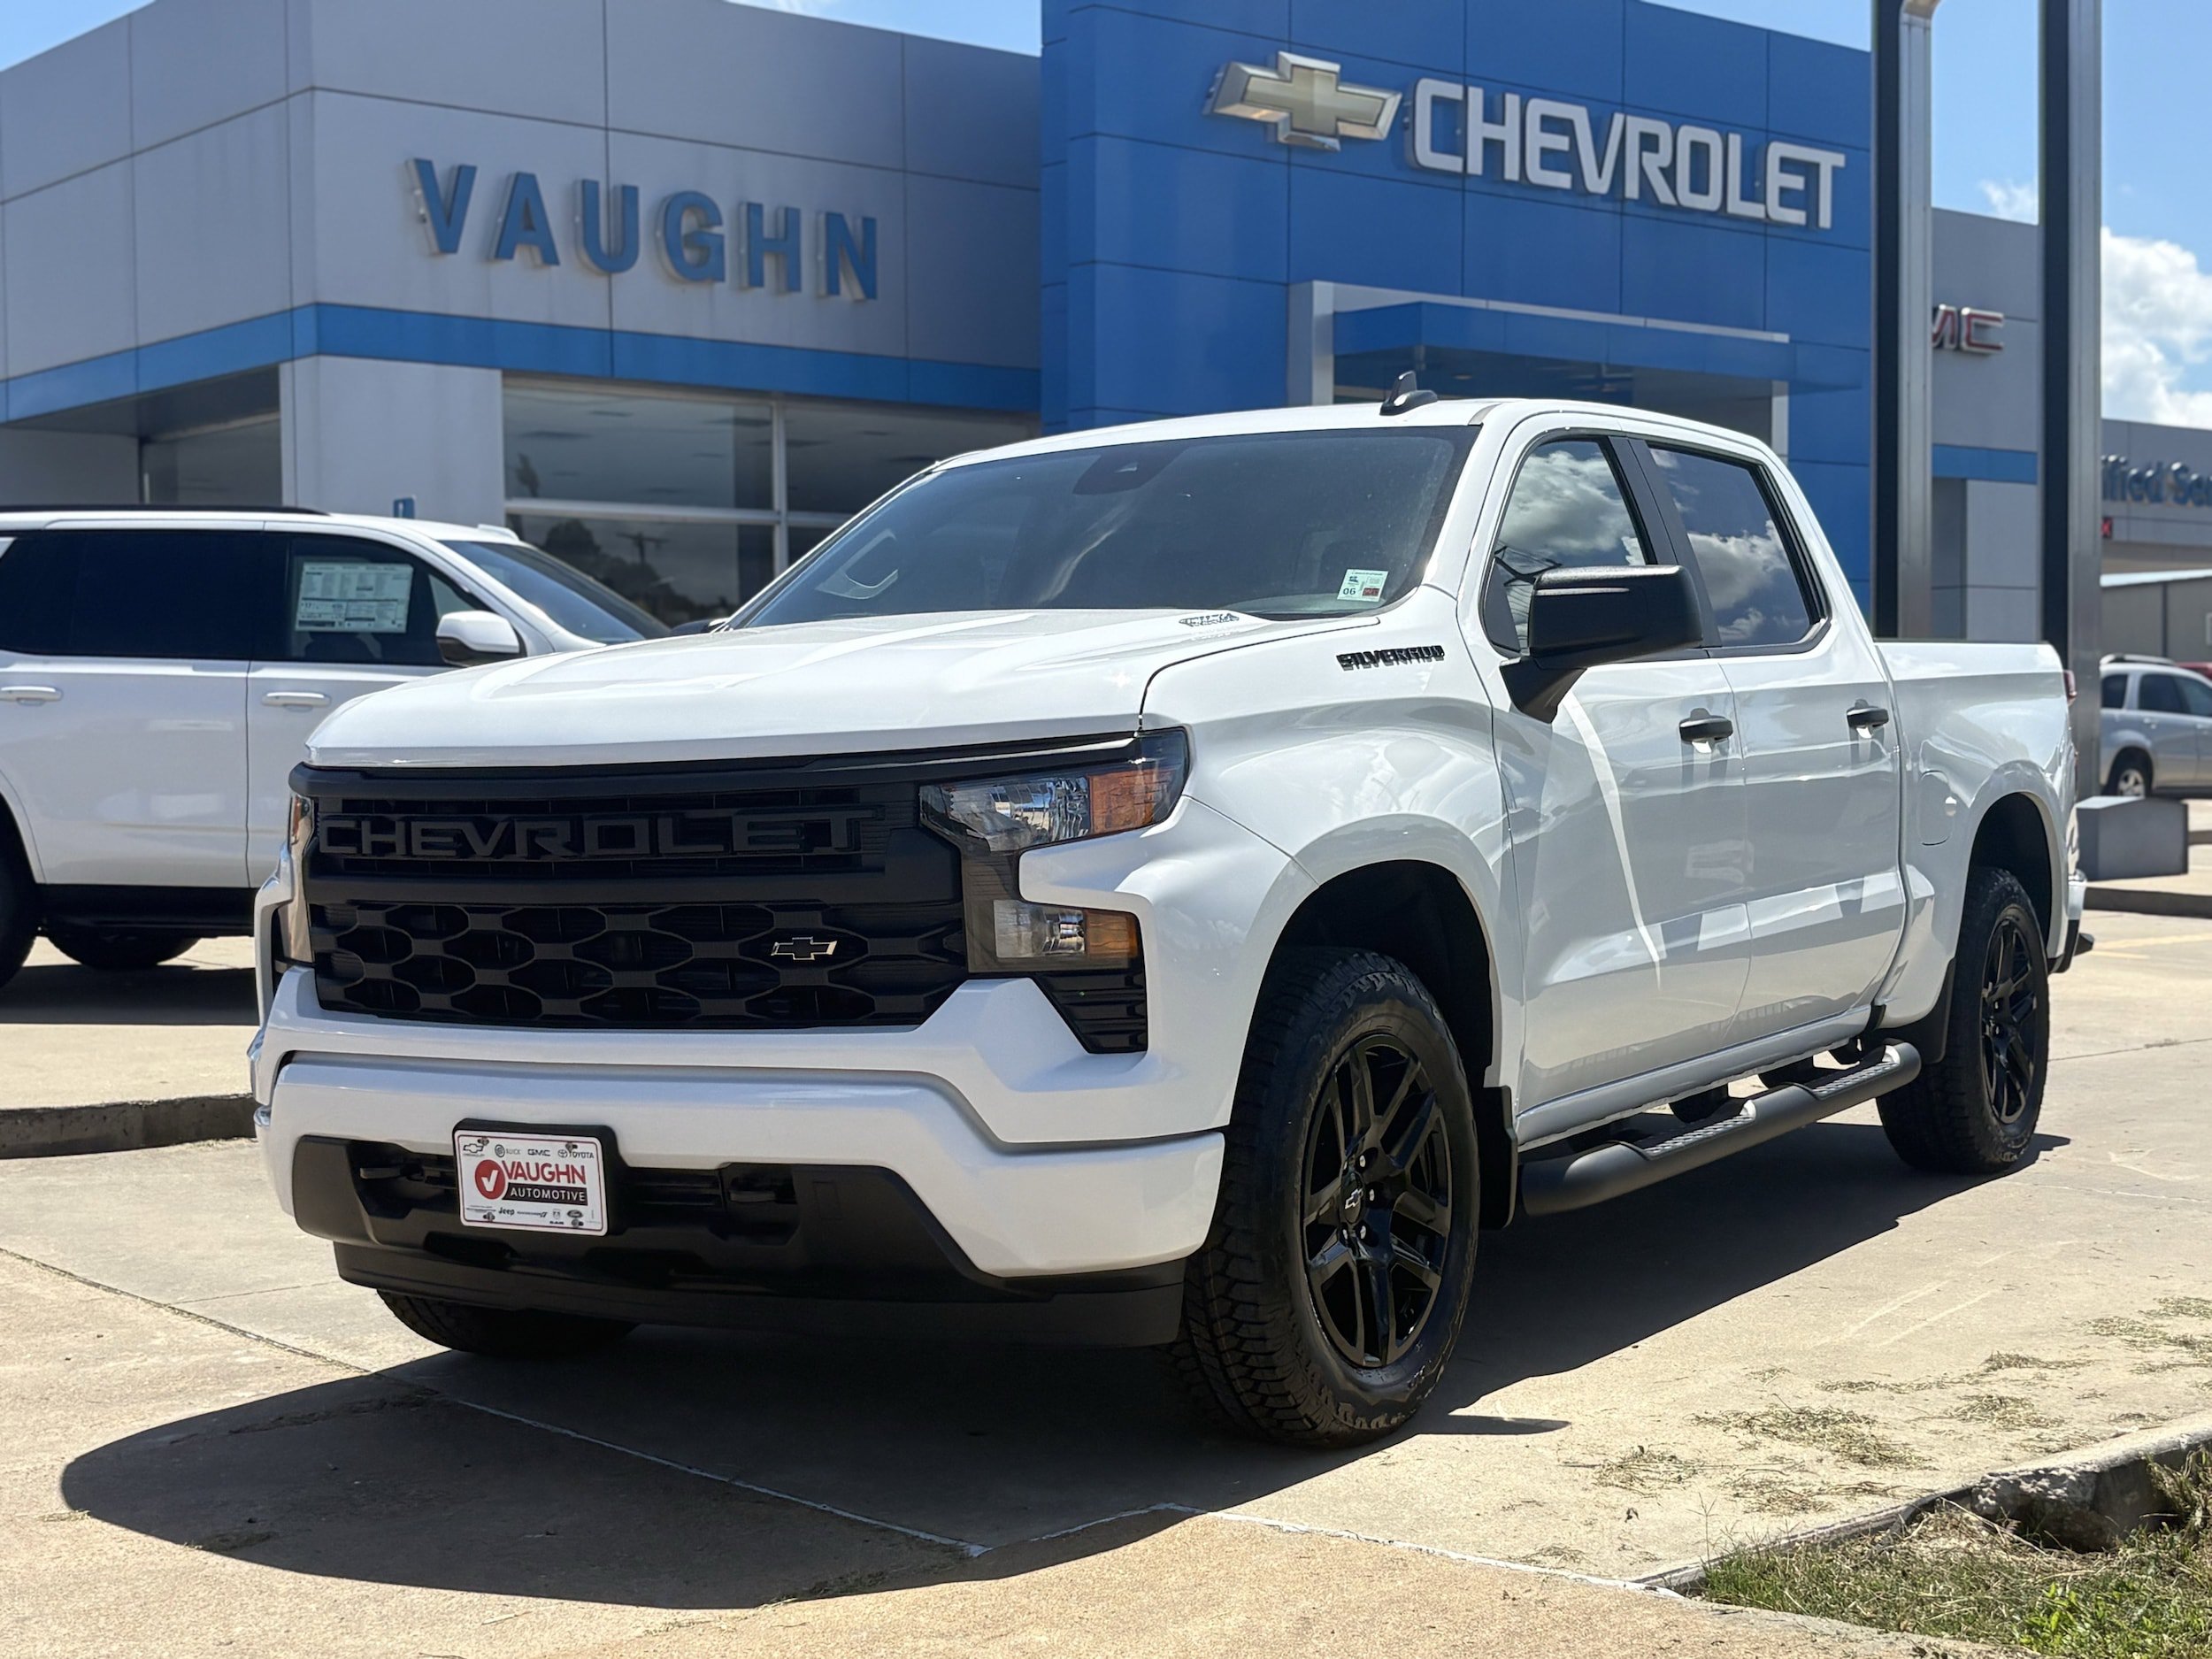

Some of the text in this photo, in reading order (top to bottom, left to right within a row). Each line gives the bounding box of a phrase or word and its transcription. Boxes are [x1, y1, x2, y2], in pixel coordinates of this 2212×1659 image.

[1410, 76, 1846, 229] CHEVROLET
[407, 157, 877, 301] VAUGHN
[1336, 645, 1445, 669] SILVERADO
[318, 805, 876, 858] CHEVROLET
[527, 1148, 550, 1157] GMC
[569, 1150, 595, 1159] TOYOTA
[502, 1160, 587, 1185] VAUGHN
[511, 1187, 585, 1202] AUTOMOTIVE
[498, 1207, 515, 1216] Jeep
